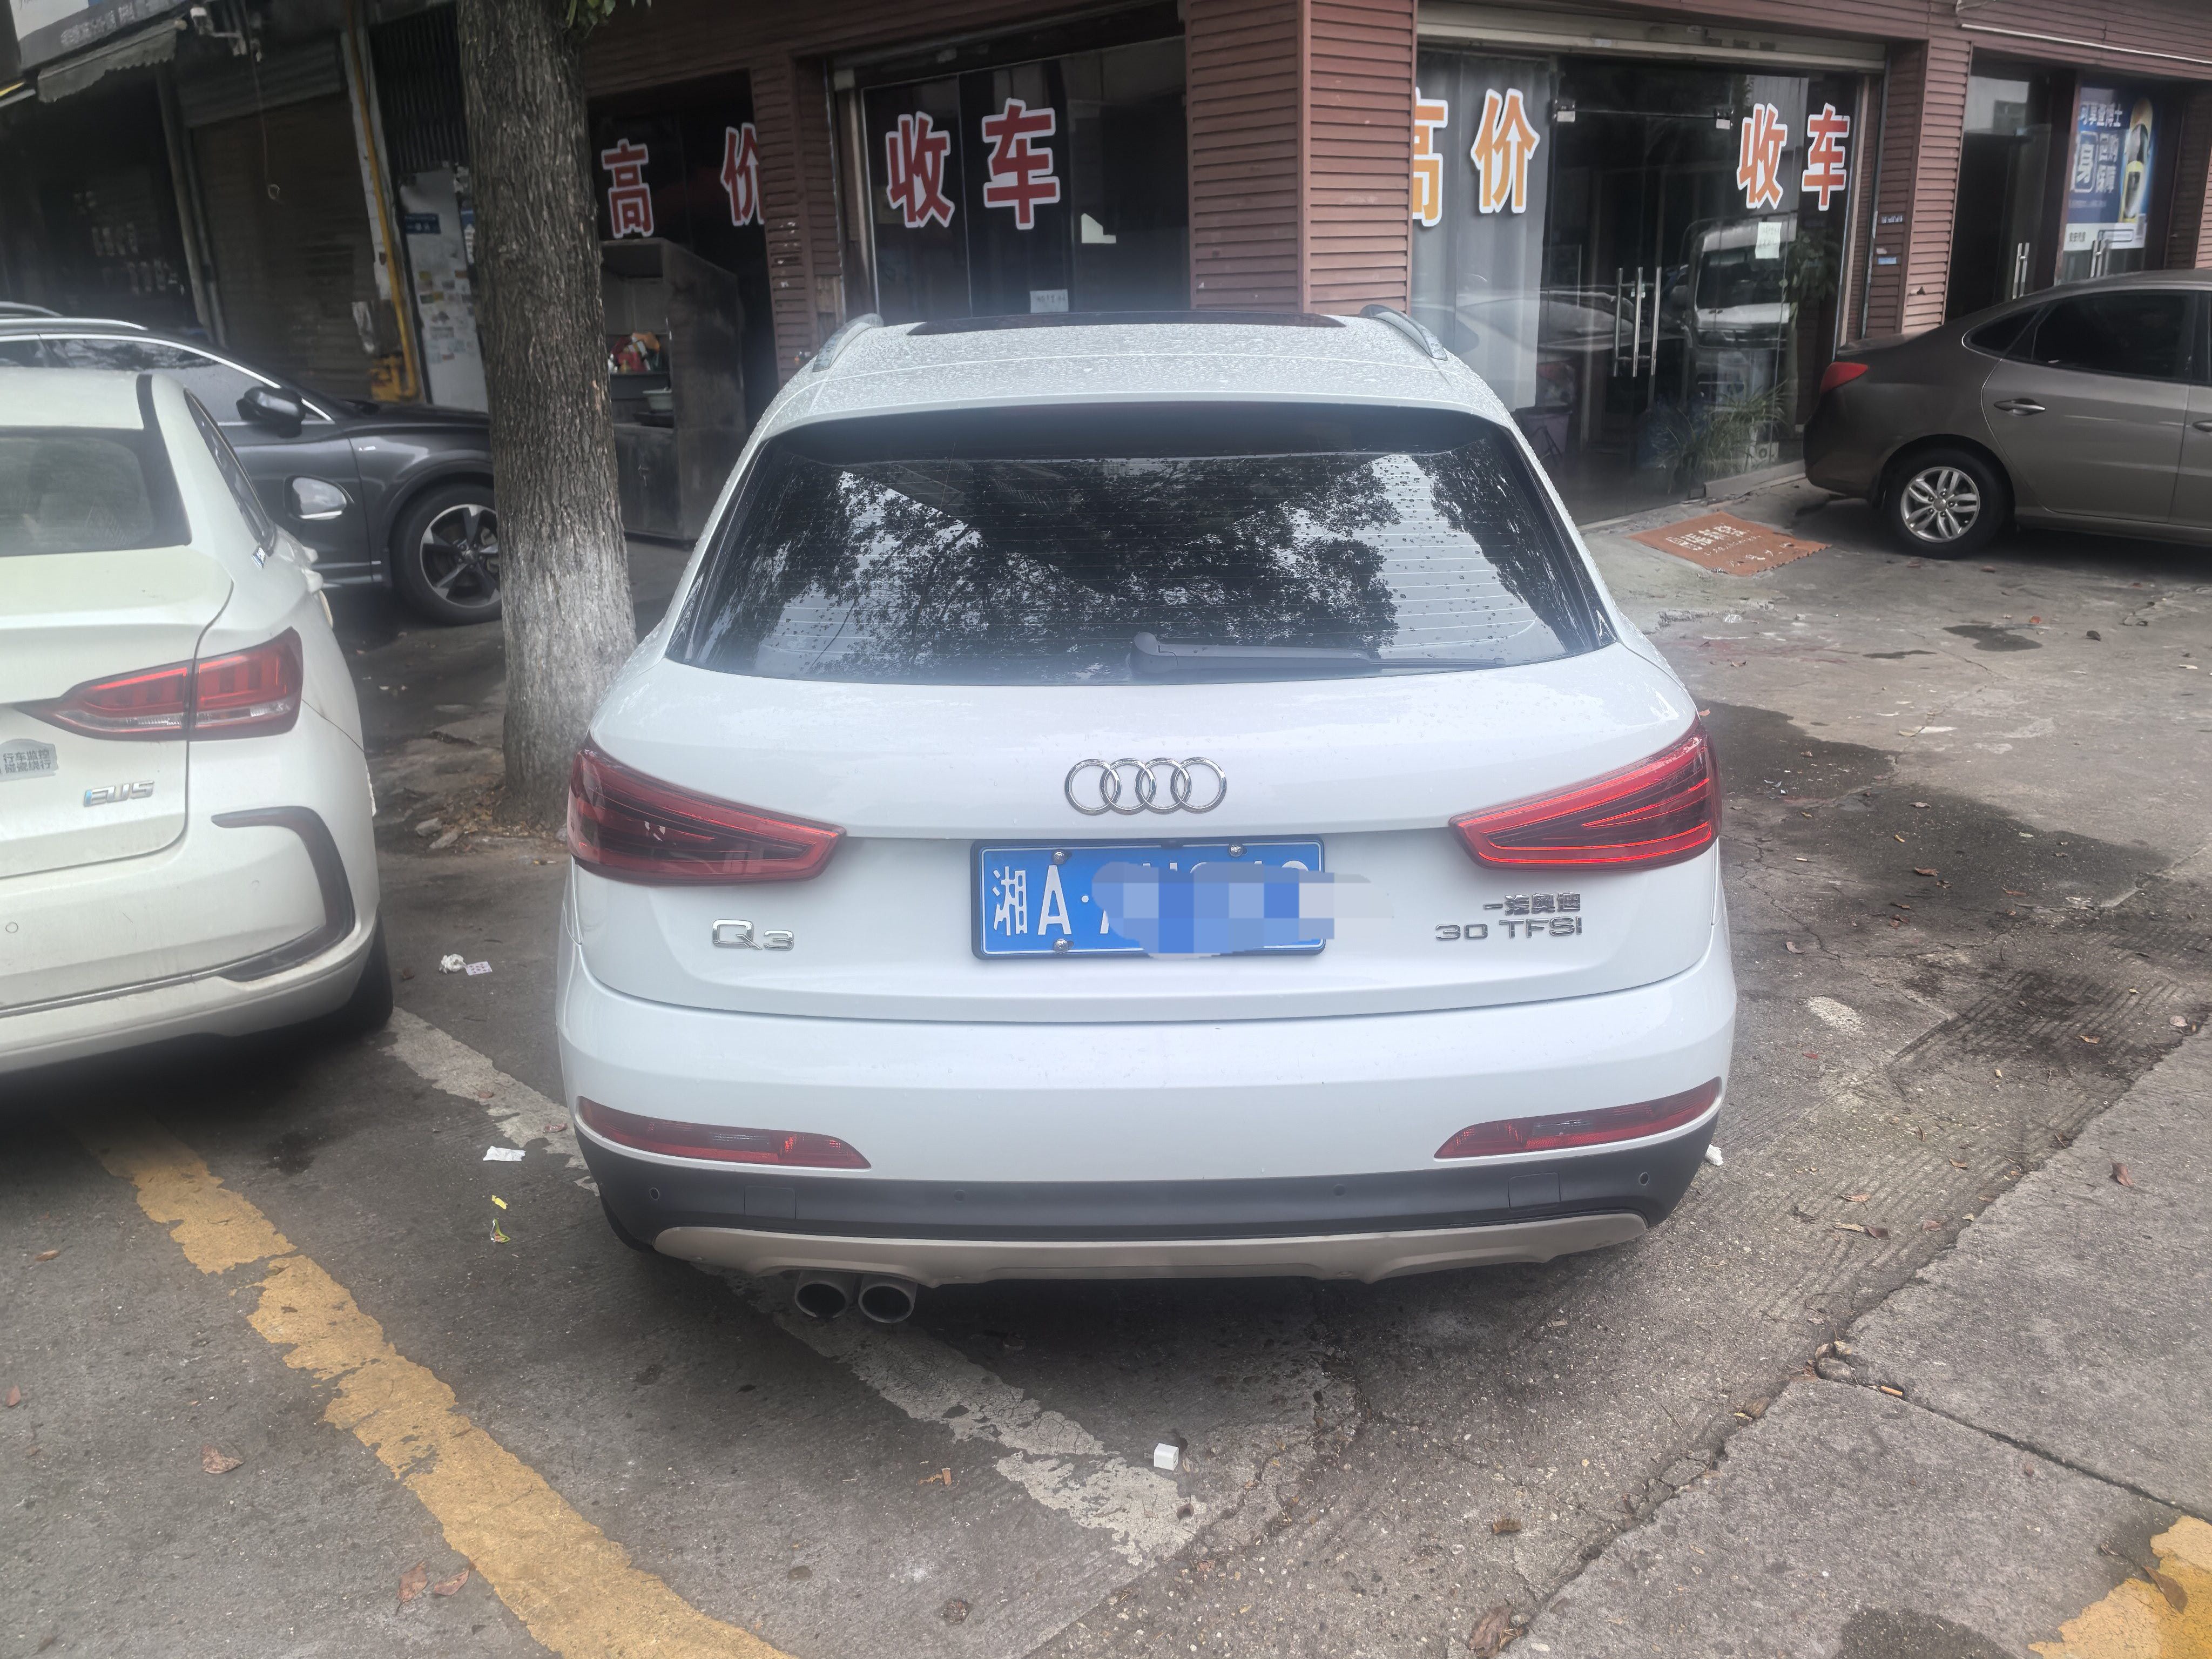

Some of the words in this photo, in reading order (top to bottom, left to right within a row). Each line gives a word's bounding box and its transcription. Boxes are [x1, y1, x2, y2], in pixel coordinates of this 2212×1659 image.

[886, 97, 1060, 230] 收车
[1737, 102, 1850, 211] 收车
[3, 748, 50, 763] 行车监控
[84, 780, 154, 807] EU5
[1483, 892, 1581, 915] 一汽奥迪
[712, 919, 794, 952] Q3
[1435, 923, 1488, 941] 30
[1498, 916, 1583, 939] TFSI
